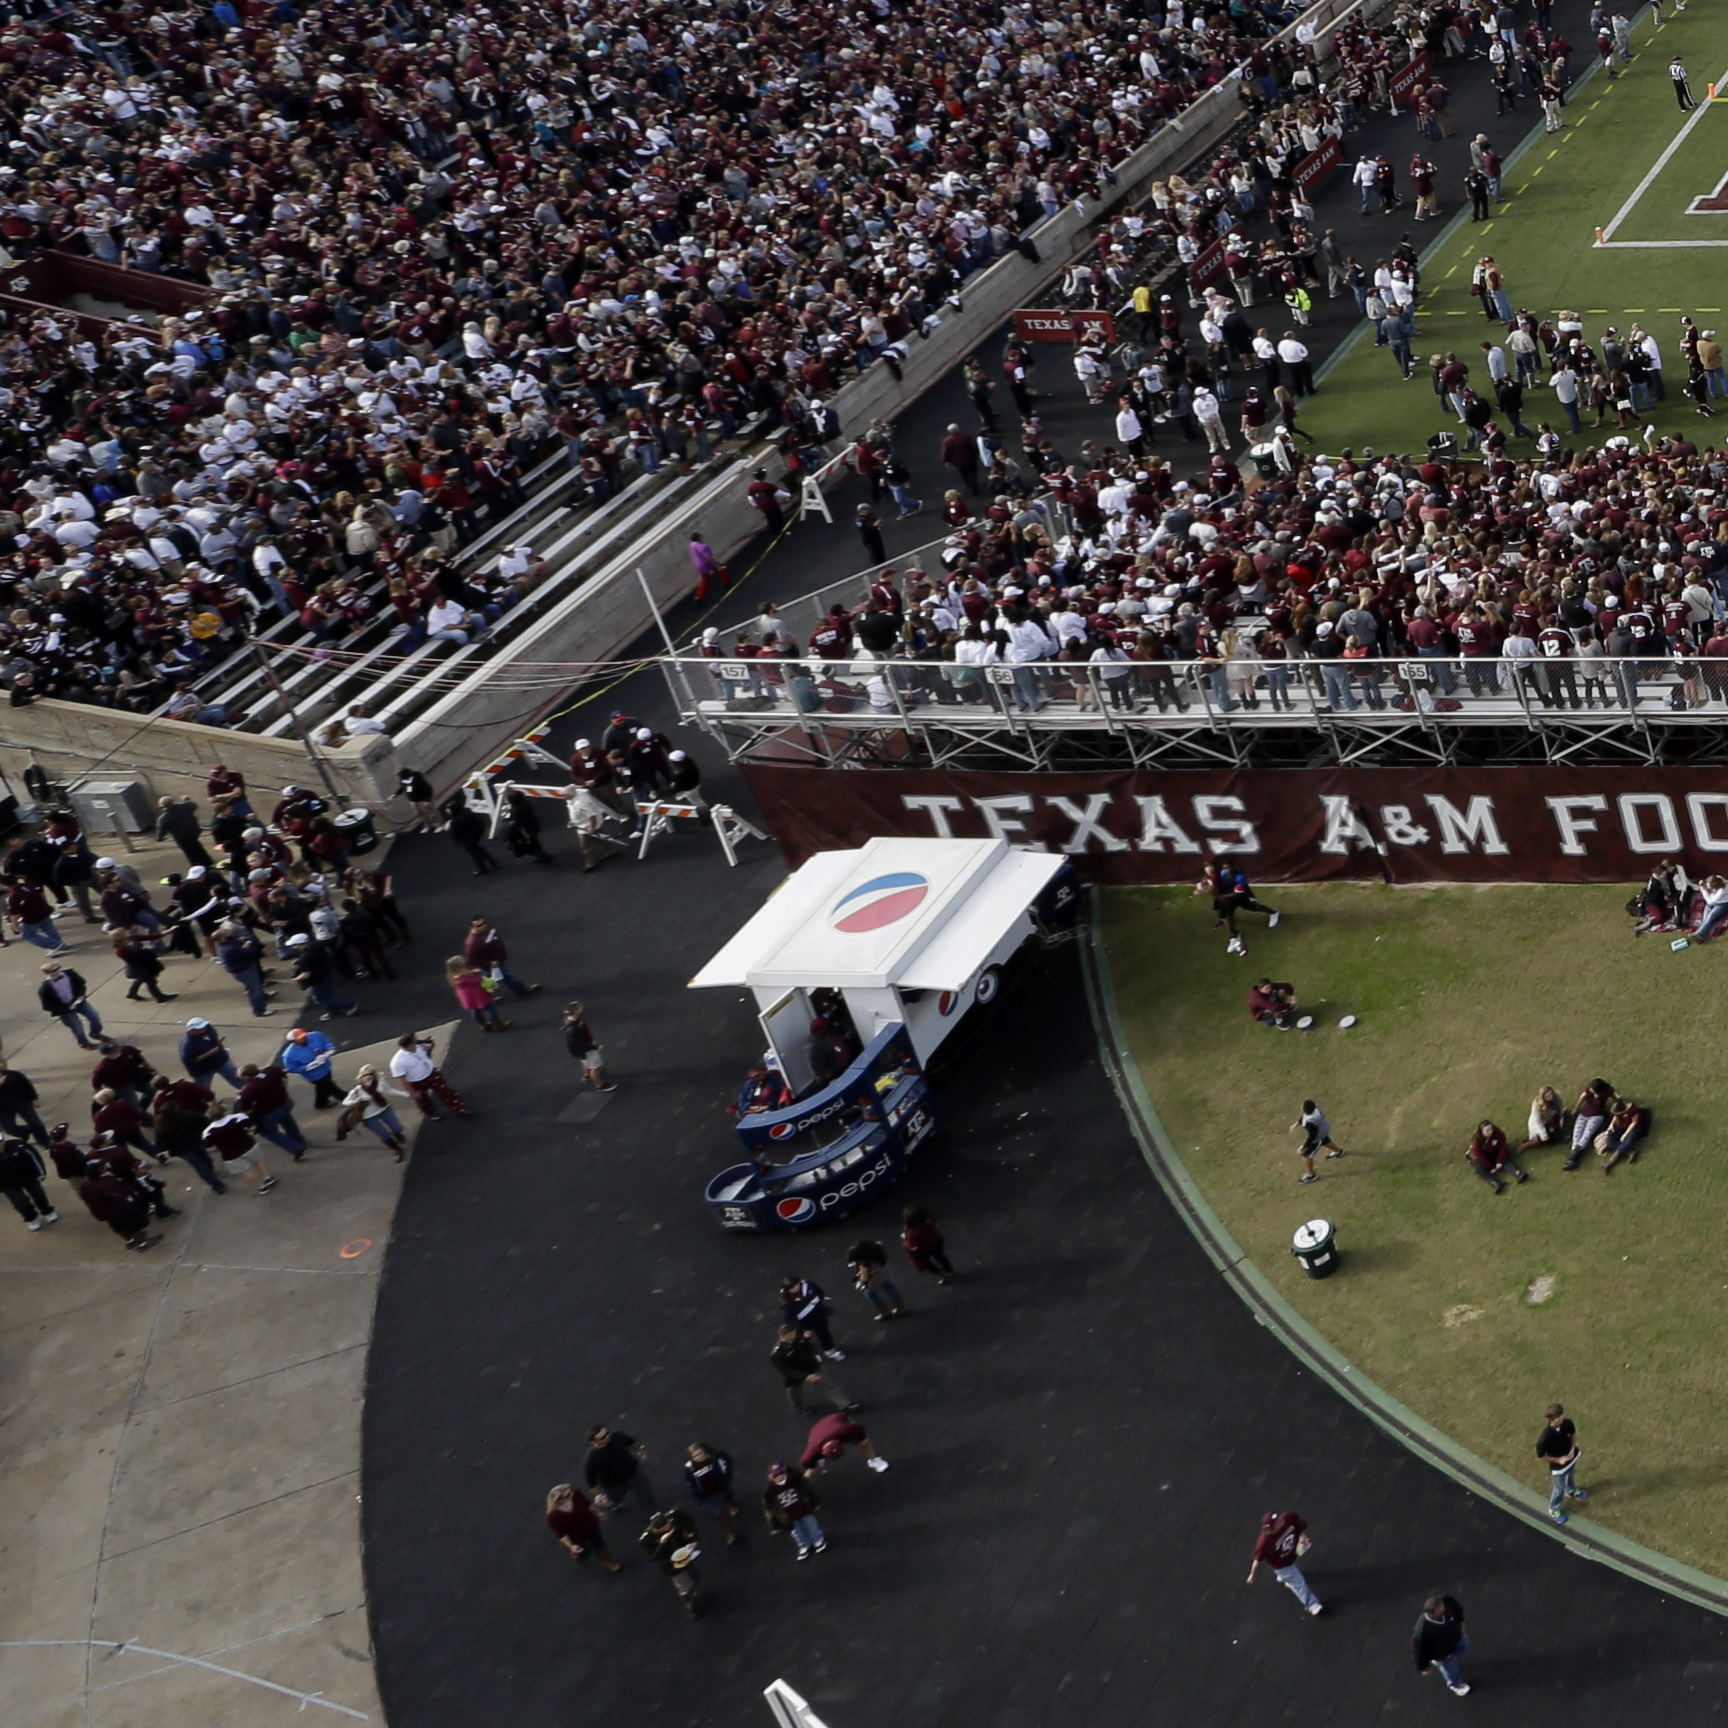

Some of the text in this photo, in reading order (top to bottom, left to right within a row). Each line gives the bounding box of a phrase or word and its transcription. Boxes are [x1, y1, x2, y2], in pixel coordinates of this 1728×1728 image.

[1394, 76, 1414, 93] TEXAS
[1300, 160, 1321, 184] TEXAS
[1197, 253, 1222, 279] TEXAS
[1024, 320, 1070, 330] TEXAS
[1542, 639, 1562, 657] 12
[721, 666, 746, 678] 157
[989, 672, 1013, 682] 56
[902, 793, 1259, 856] TEXAS
[1319, 793, 1509, 857] A&M
[798, 1097, 845, 1131] pepsi
[820, 1153, 893, 1210] pepsi
